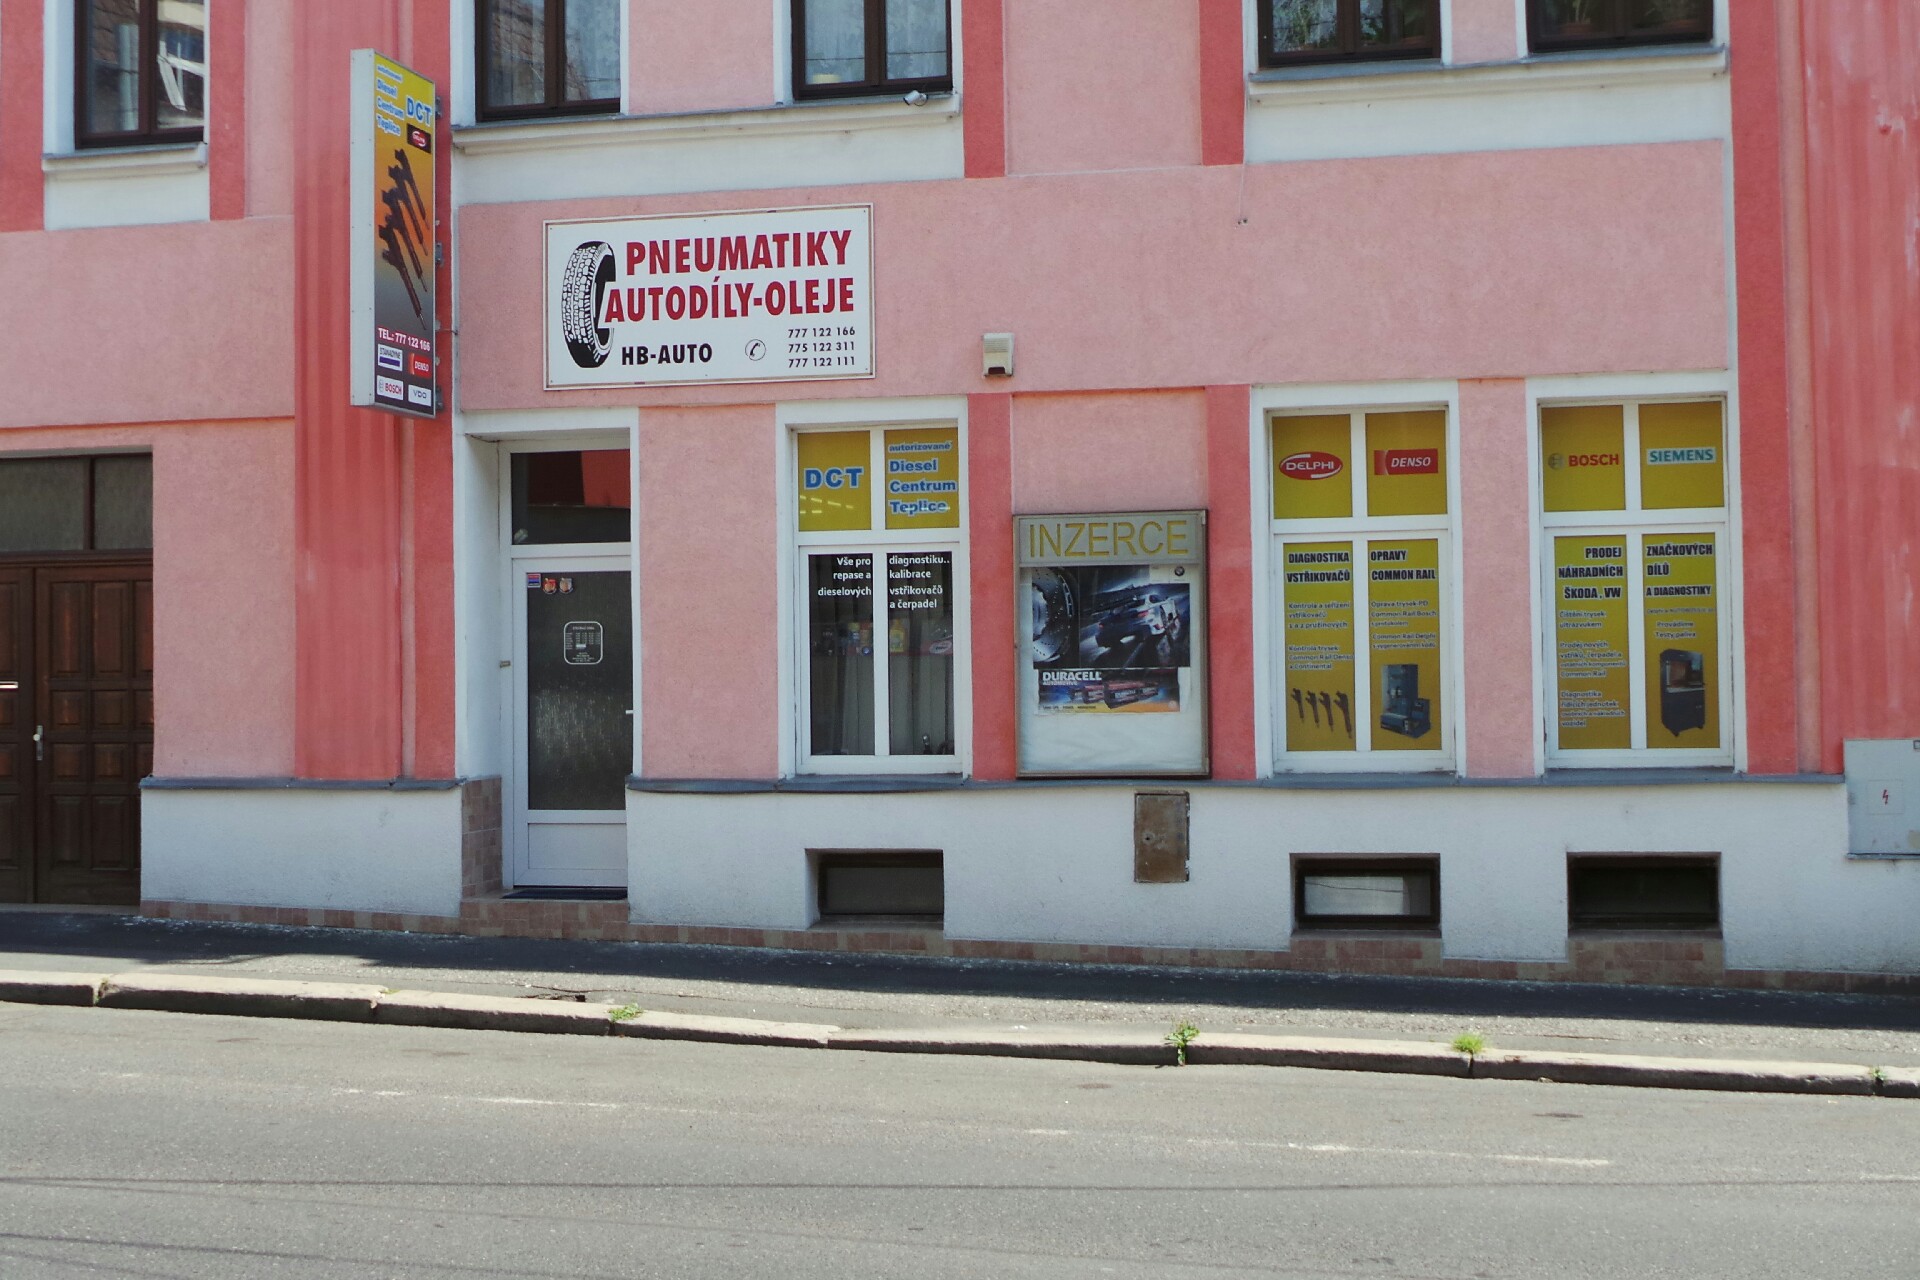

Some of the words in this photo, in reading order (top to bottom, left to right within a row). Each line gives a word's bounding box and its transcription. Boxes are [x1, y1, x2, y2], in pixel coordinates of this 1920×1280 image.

[407, 97, 431, 126] DCT
[626, 230, 852, 276] PNEUMATIKY
[604, 276, 854, 323] AUTODÍLY-OLEJE
[788, 328, 808, 338] 777
[813, 327, 831, 337] 122
[837, 326, 855, 336] 166
[395, 332, 407, 345] 777
[408, 337, 419, 349] 122
[420, 340, 431, 352] 166
[788, 343, 808, 353] 775
[813, 342, 831, 352] 122
[836, 341, 854, 351] 311
[622, 343, 713, 366] HB-AUTO
[415, 361, 429, 372] DENSO
[788, 358, 808, 368] 777
[813, 357, 832, 367] 122
[837, 356, 855, 366] 111
[385, 382, 402, 395] BOSCH
[413, 389, 427, 399] VDO
[889, 440, 951, 452] autorizované
[1568, 453, 1619, 466] BOSCH
[1649, 449, 1713, 462] SIEMENS
[889, 459, 937, 472] Diesel
[1286, 461, 1334, 471] DELPHI
[1391, 457, 1431, 468] DENSO
[804, 468, 863, 488] DCT
[889, 480, 956, 493] Centrum
[889, 500, 948, 515] Teplice
[1029, 519, 1188, 557] INZERCE
[1370, 550, 1406, 561] OPRAVY
[1585, 547, 1622, 558] PRODEJ
[1647, 543, 1713, 556] ZNAČKOVÝCH
[837, 556, 853, 566] Vše
[855, 558, 871, 568] pro
[1288, 552, 1350, 563] DIAGNOSTIKA
[890, 569, 931, 579] kalibrace
[1372, 569, 1414, 580] COMMON
[1416, 568, 1436, 580] RAIL
[1558, 565, 1623, 578] NÁHRADNÍCH
[1647, 562, 1670, 575] DÍLŮ
[833, 571, 864, 582] repase
[1287, 569, 1350, 582] VSTŘIKOVAČŮ
[818, 586, 872, 598] dieselových
[890, 585, 943, 595] vstřikovačů
[1564, 585, 1598, 599] ŠKODA
[1604, 587, 1621, 598] VW
[1646, 587, 1652, 596] A
[1654, 586, 1711, 596] DIAGNOSTIKY
[890, 601, 895, 609] a
[897, 599, 937, 610] čerpadel
[1042, 671, 1103, 681] DURACELL
